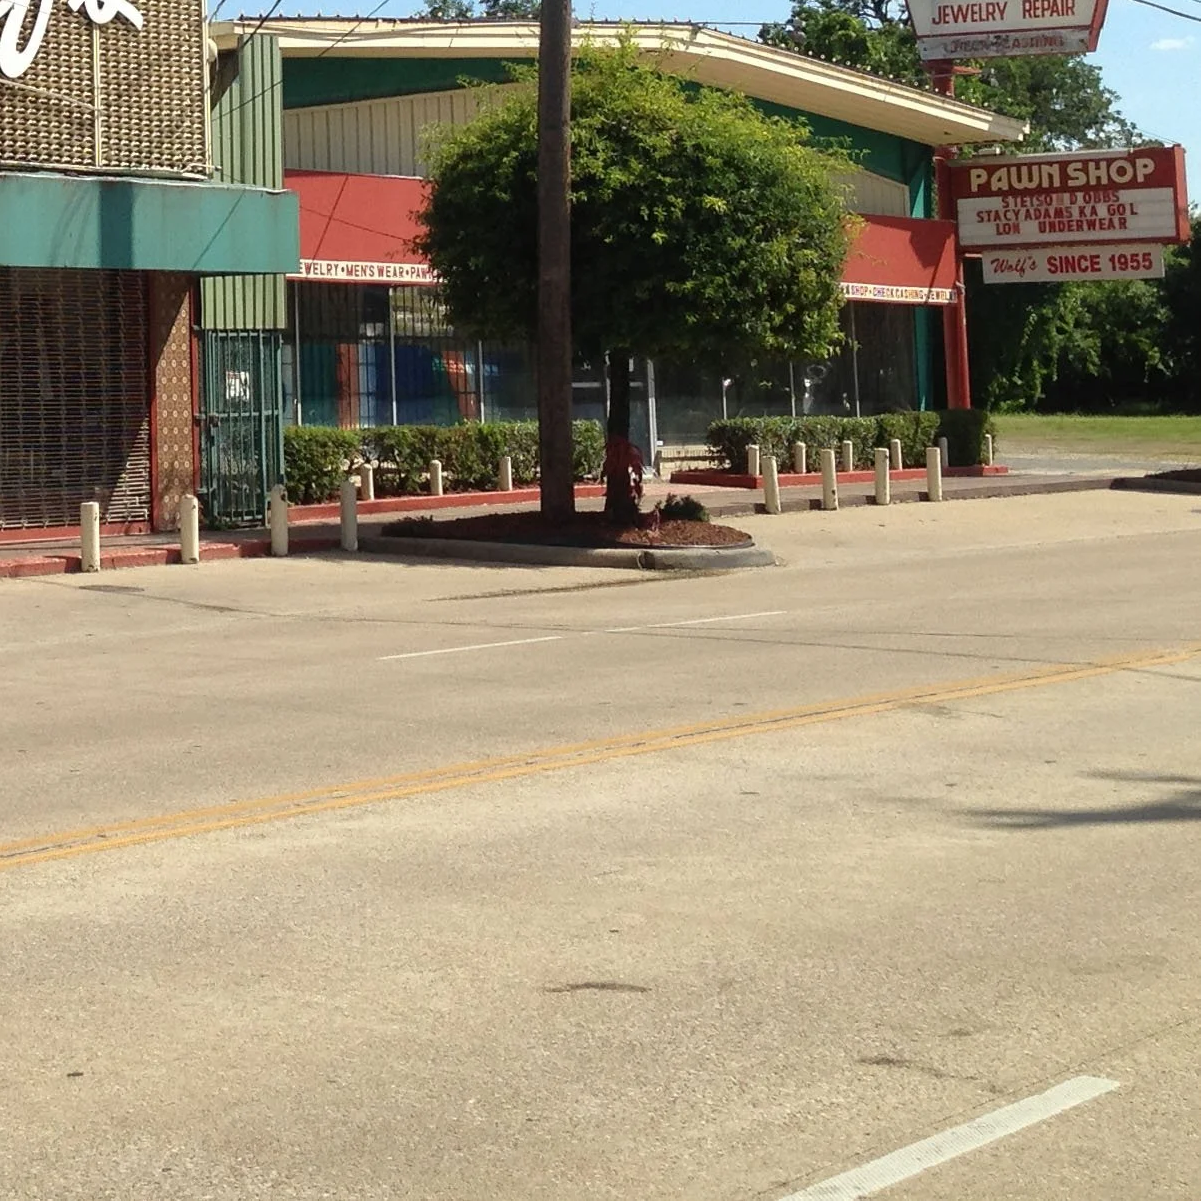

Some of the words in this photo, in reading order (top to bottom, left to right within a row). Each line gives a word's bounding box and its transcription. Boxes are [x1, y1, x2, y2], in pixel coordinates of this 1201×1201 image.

[932, 1, 1007, 25] JEWELRY
[970, 163, 1060, 192] PAWN
[1066, 158, 1155, 187] SHOP
[976, 209, 1021, 223] STACY
[1024, 206, 1073, 220] ADAMS
[1038, 217, 1127, 233] UNDERWEAR
[299, 262, 339, 276] EWELRY
[377, 265, 404, 278] WEAR
[990, 256, 1038, 278] Wolf's
[1047, 254, 1101, 274] SINCE
[1108, 252, 1153, 272] 1955
